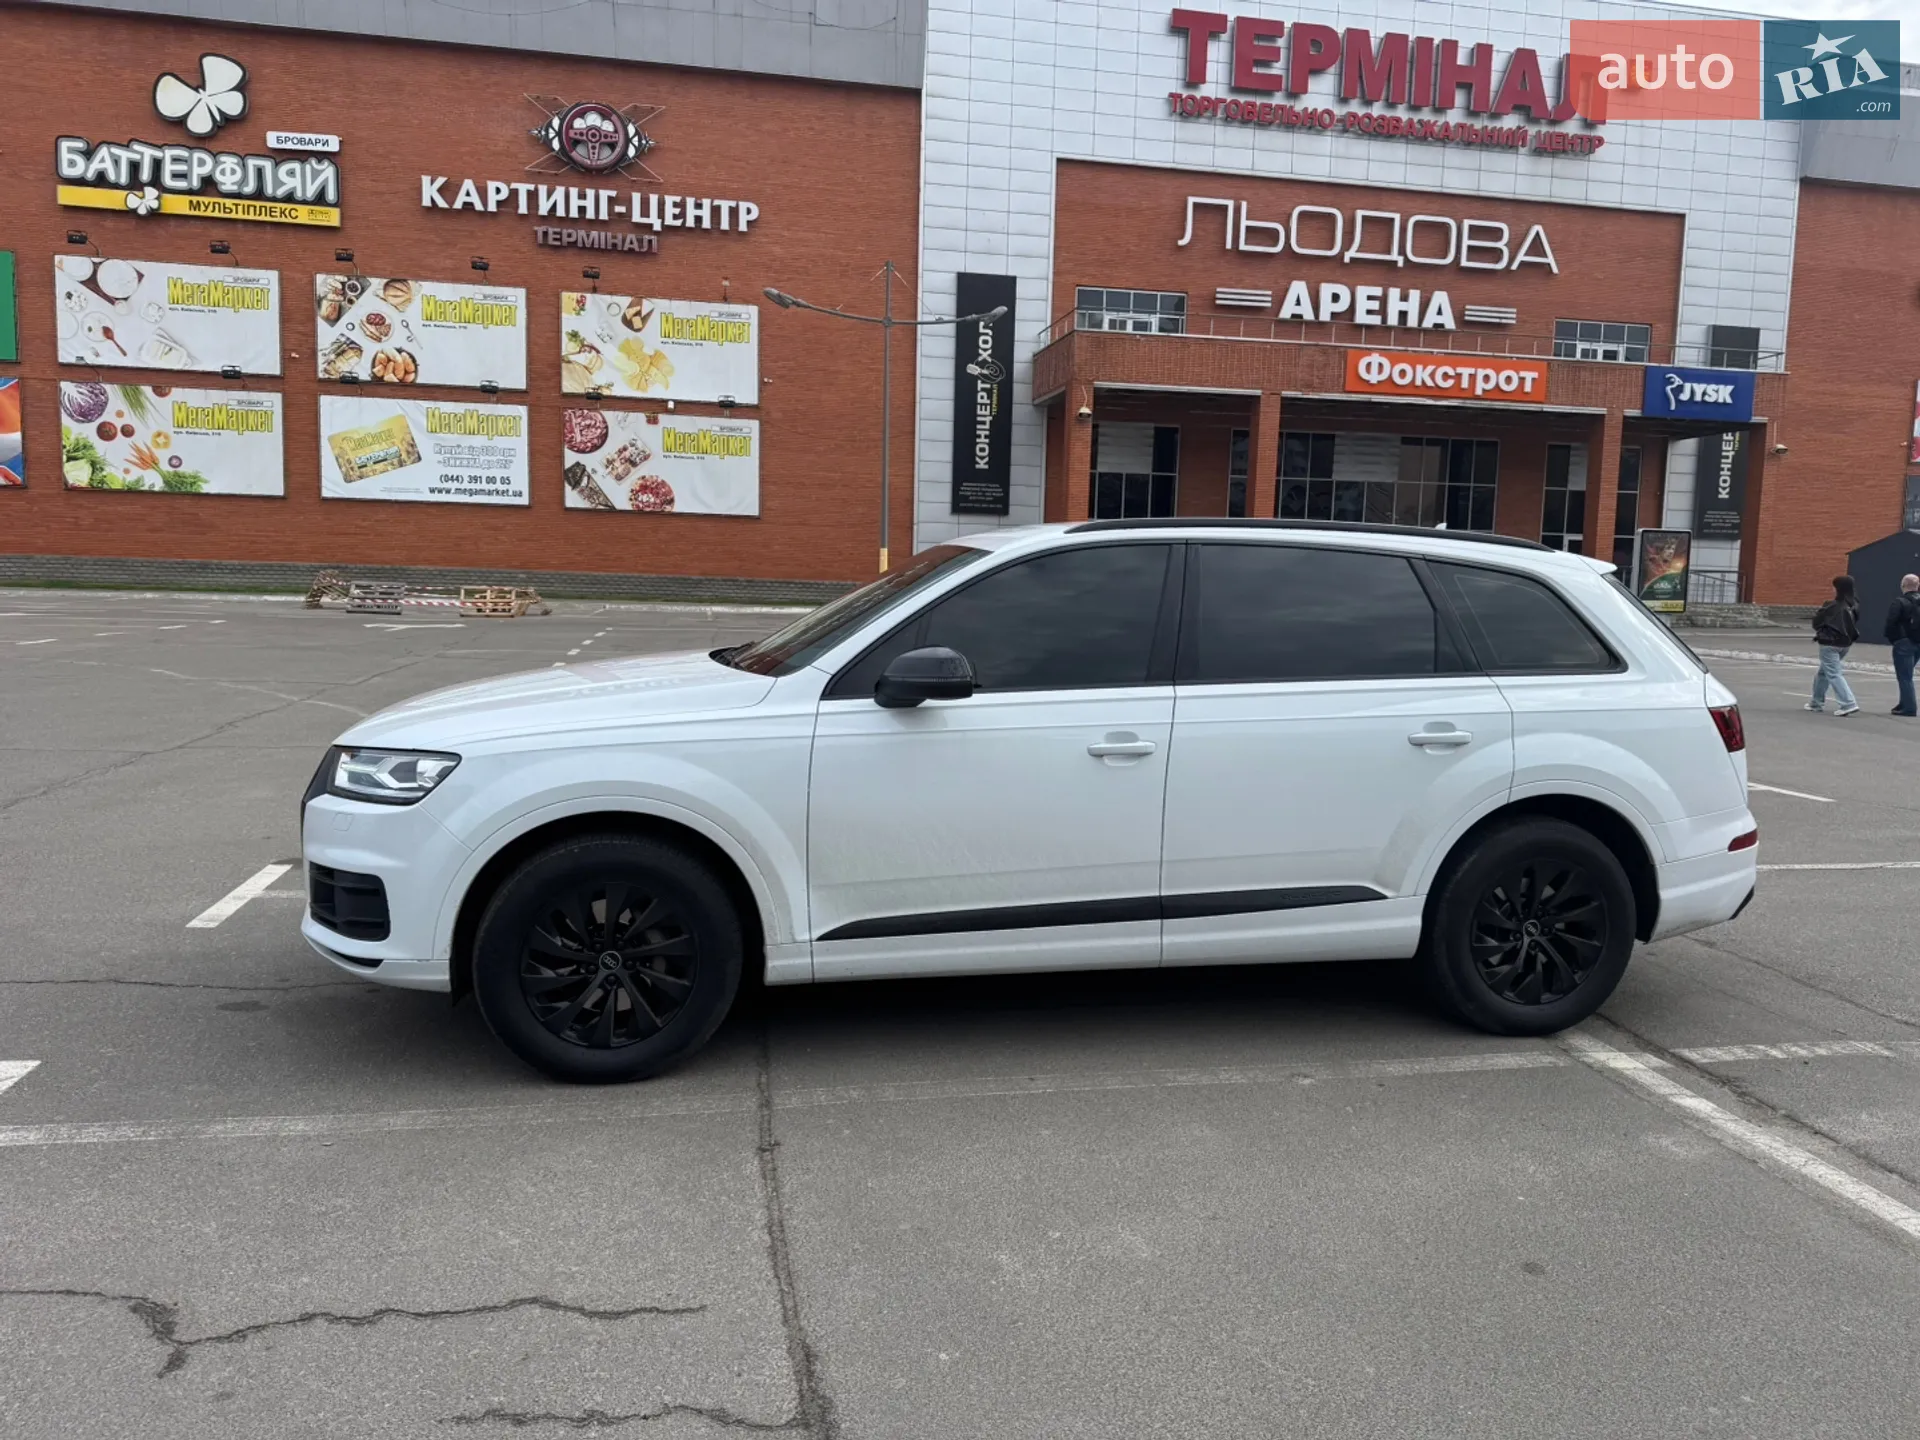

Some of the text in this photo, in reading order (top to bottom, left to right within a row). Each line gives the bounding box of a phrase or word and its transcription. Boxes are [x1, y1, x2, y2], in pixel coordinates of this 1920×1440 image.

[1170, 9, 1607, 125] ТЕРМІНАЛ
[1168, 92, 1605, 154] ТОРГОВЕЛЬНО-РОЗВАЖАЛЬНИЙ ЦЕНТР
[275, 136, 330, 148] БРОВАРИ
[58, 136, 339, 204] БАТТЕРФЛЯЙ
[188, 199, 299, 220] МУЛЬТІПЛЕКС
[420, 175, 760, 232] КАРТИНГ-ЦЕНТР
[533, 226, 658, 253] ТЕРМІНАЛ
[1177, 195, 1560, 275] ЛЬОДОВА
[167, 276, 270, 313] МегаМаркет
[422, 294, 517, 329] МегаМаркет
[1278, 280, 1456, 330] АРЕНА
[660, 312, 751, 346] МегаМаркет
[1357, 352, 1539, 396] Фокстрот
[1678, 382, 1735, 404] JYSK
[172, 400, 274, 435] МегаМаркет
[426, 407, 522, 441] МегаМаркет
[975, 380, 993, 470] КОНЦЕРТ
[662, 427, 752, 460] МегаМаркет
[428, 486, 523, 498] www.megamarket.ua
[439, 474, 464, 485] (044)
[467, 474, 483, 485] 391
[485, 475, 497, 485] 00
